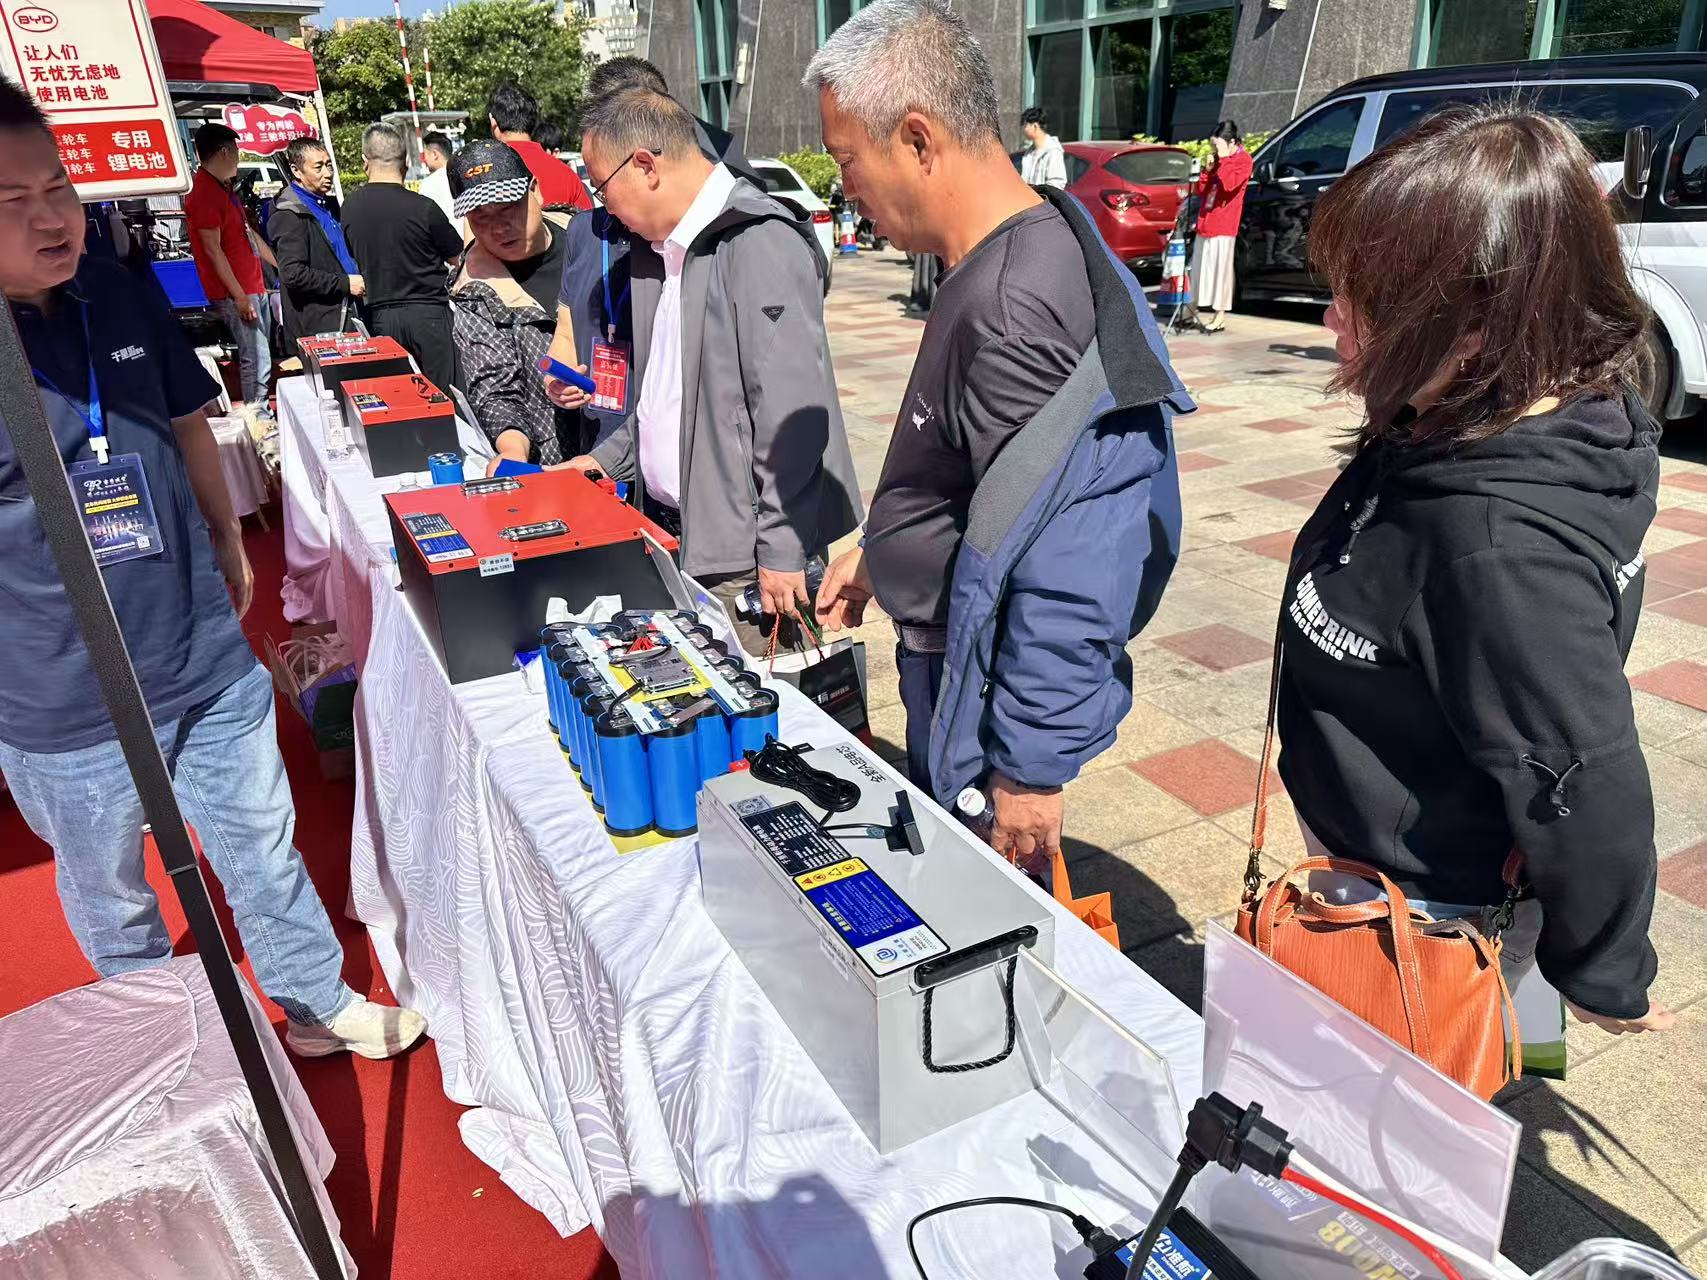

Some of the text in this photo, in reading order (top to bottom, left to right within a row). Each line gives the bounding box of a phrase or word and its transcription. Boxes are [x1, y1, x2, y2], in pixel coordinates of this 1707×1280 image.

[18, 15, 54, 25] BYD
[23, 44, 79, 62] 让人们
[30, 63, 121, 82] 无忧无虑地
[36, 84, 109, 102] 使用电池
[111, 129, 152, 149] 专用
[107, 151, 168, 172] 锂电池
[464, 162, 494, 178] CST
